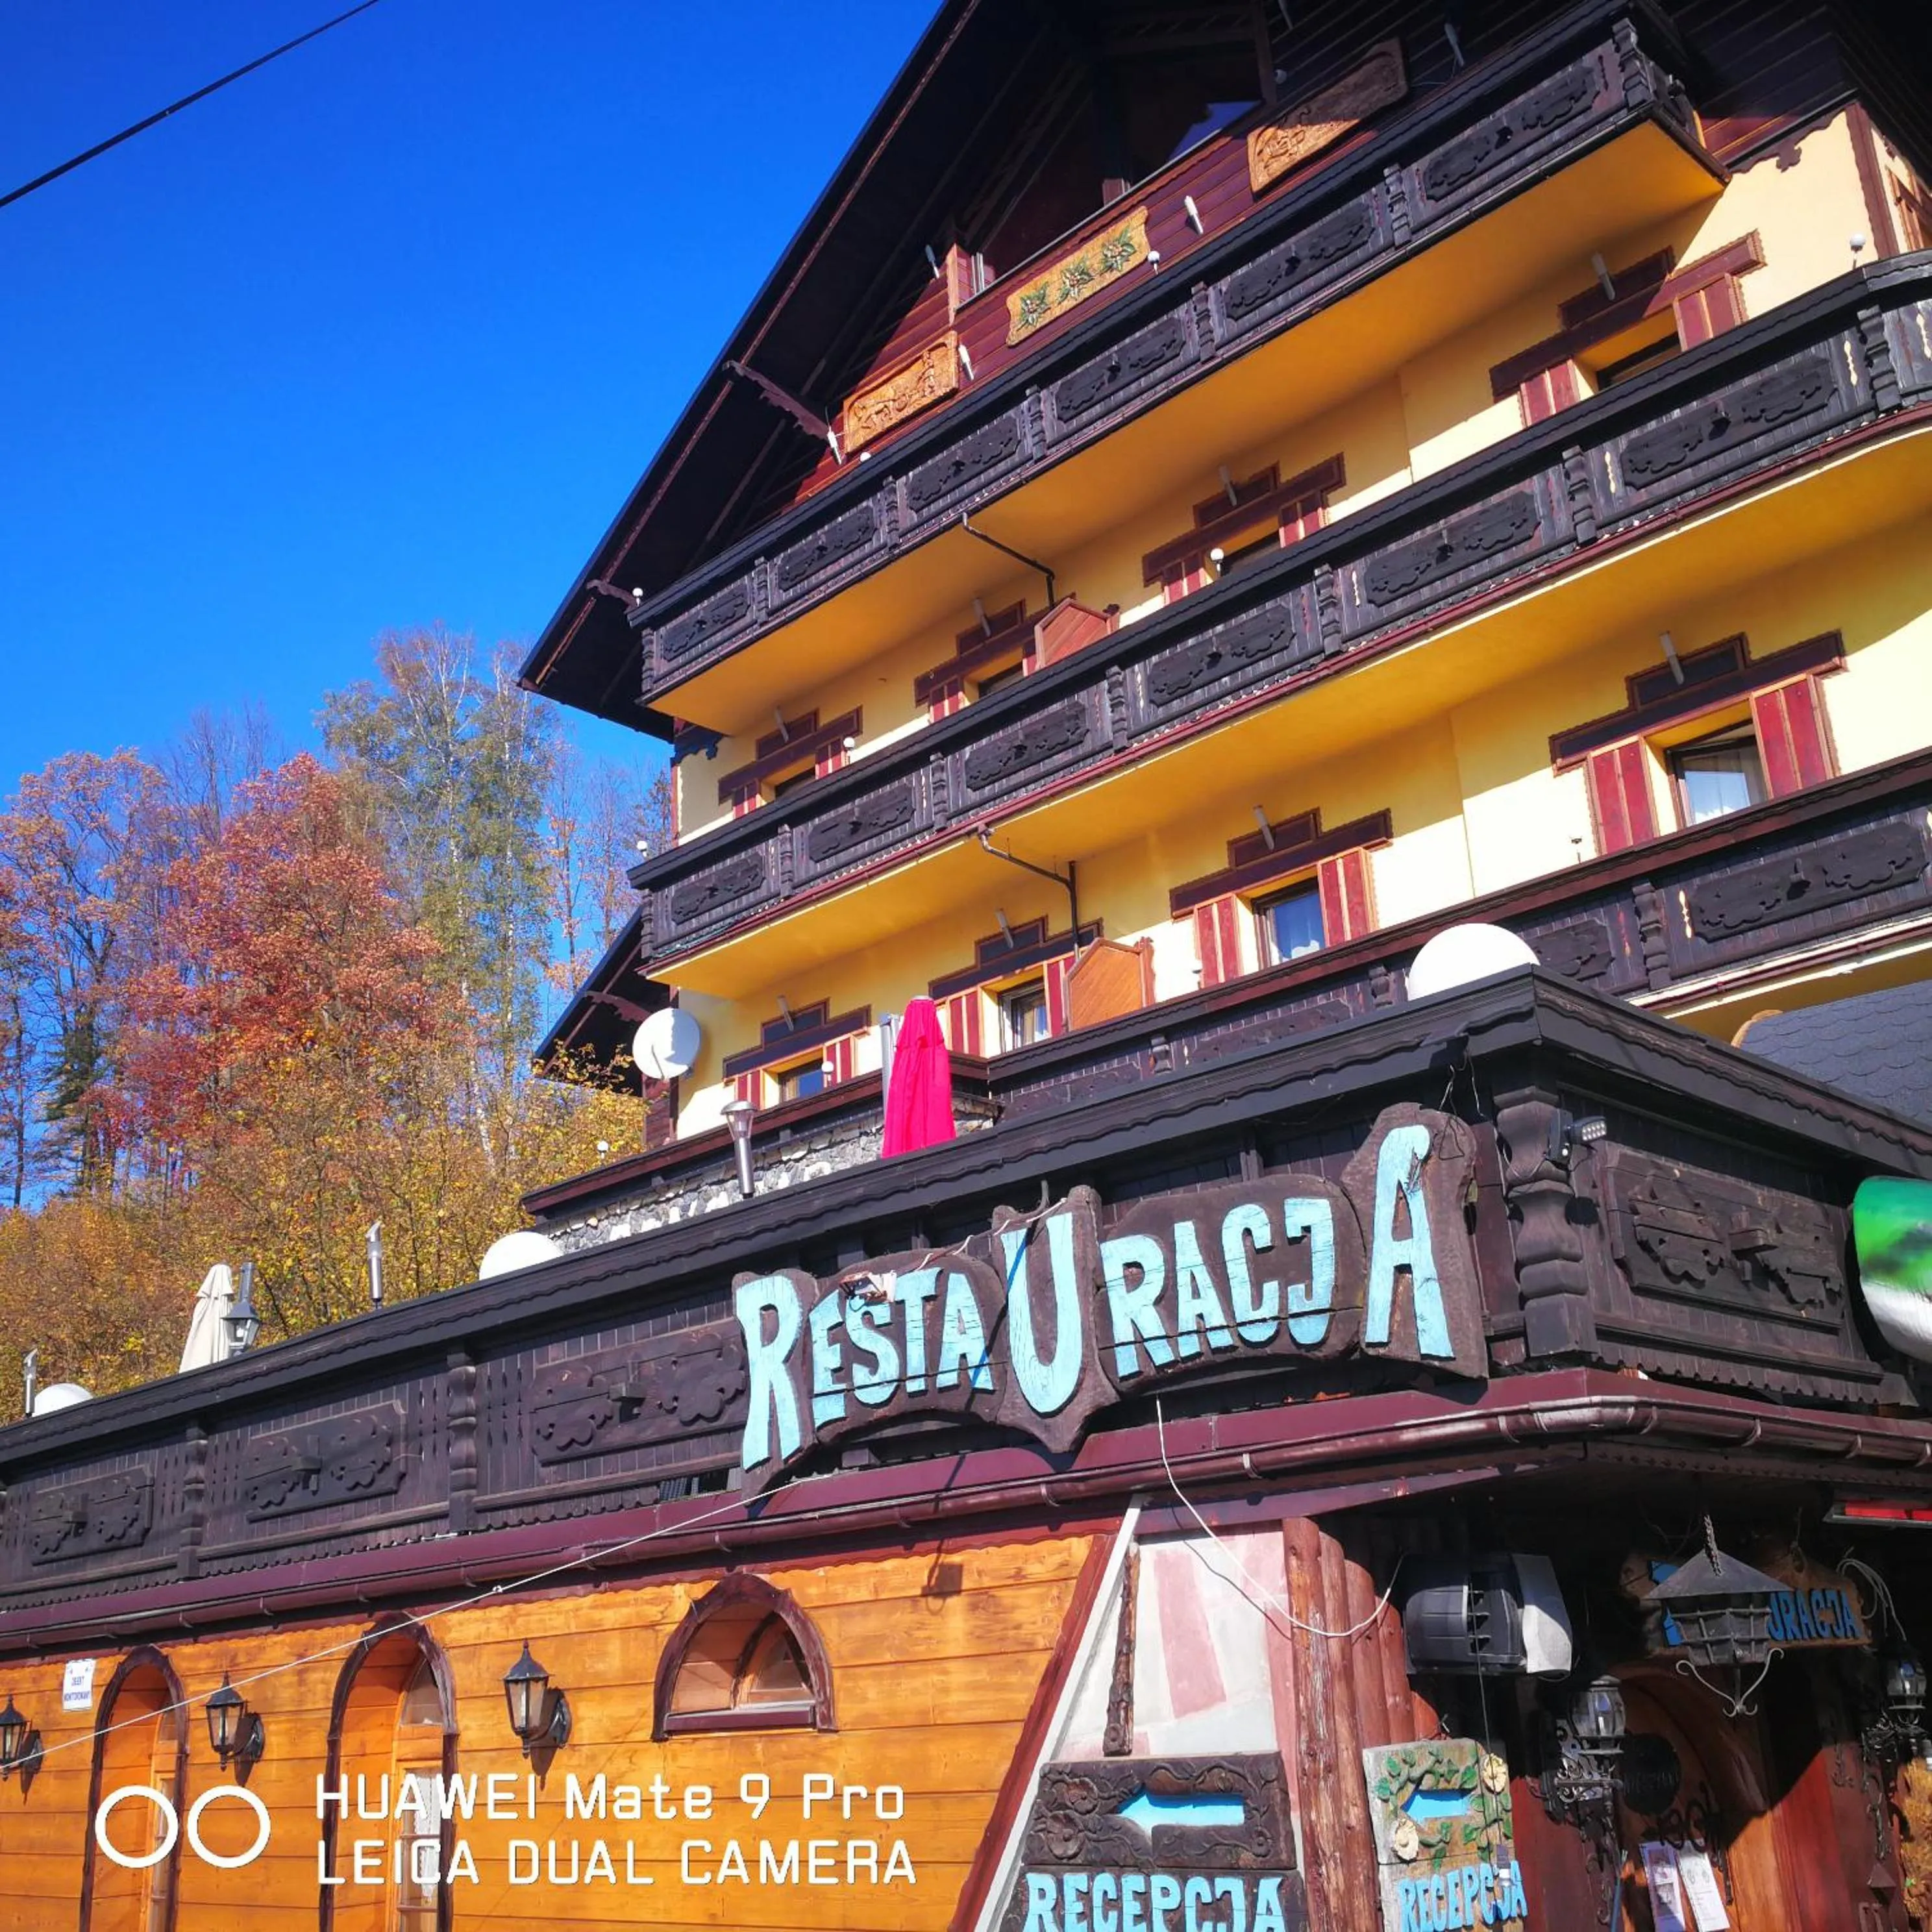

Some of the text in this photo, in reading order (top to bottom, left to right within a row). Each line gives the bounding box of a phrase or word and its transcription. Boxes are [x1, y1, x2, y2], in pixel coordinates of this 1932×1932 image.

[736, 1124, 1454, 1470] RESTAURACJA
[1022, 1872, 1286, 1932] RECEPCJA
[1398, 1860, 1528, 1932] RECEPCJA
